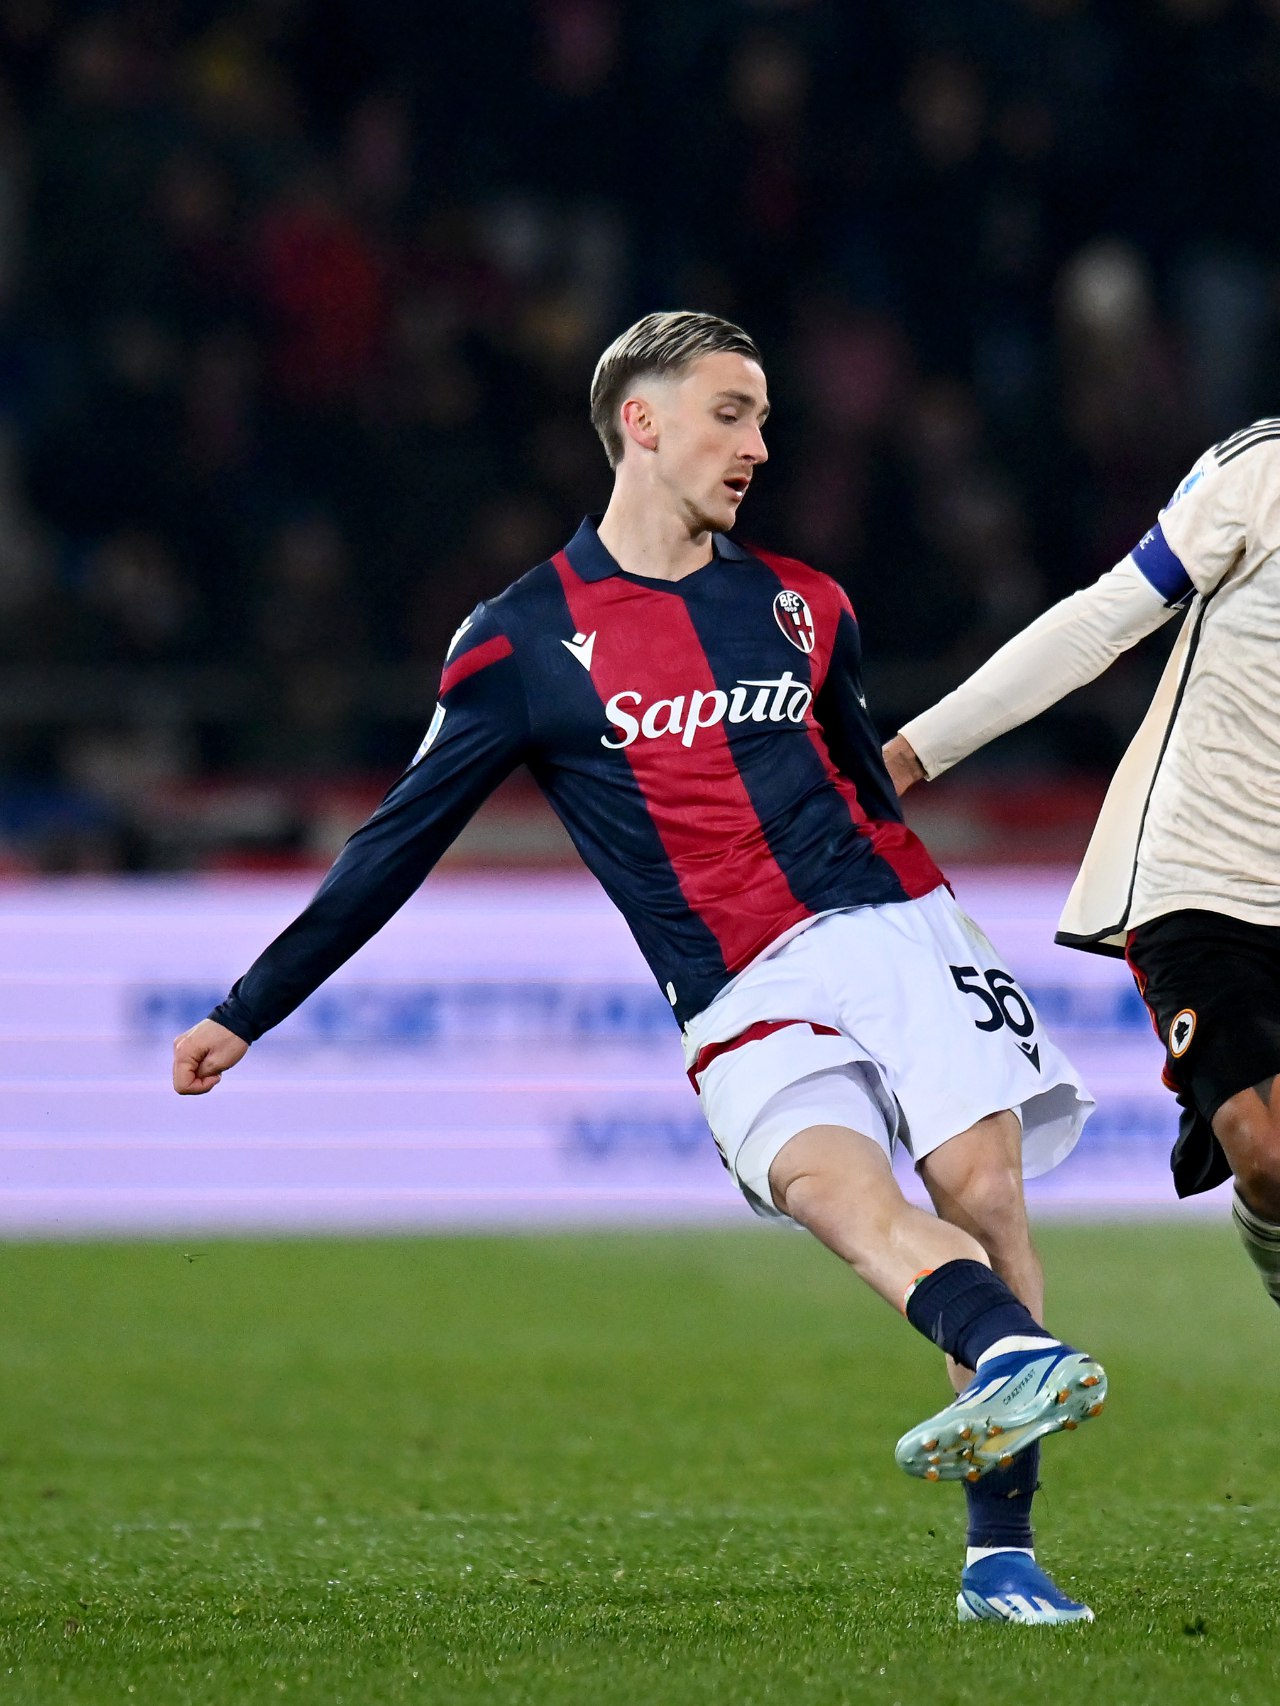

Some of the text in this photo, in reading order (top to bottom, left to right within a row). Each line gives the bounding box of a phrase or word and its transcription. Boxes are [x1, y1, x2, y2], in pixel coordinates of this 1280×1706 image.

[779, 593, 800, 607] BFC
[600, 671, 813, 749] Saputo
[949, 965, 1034, 1038] 56
